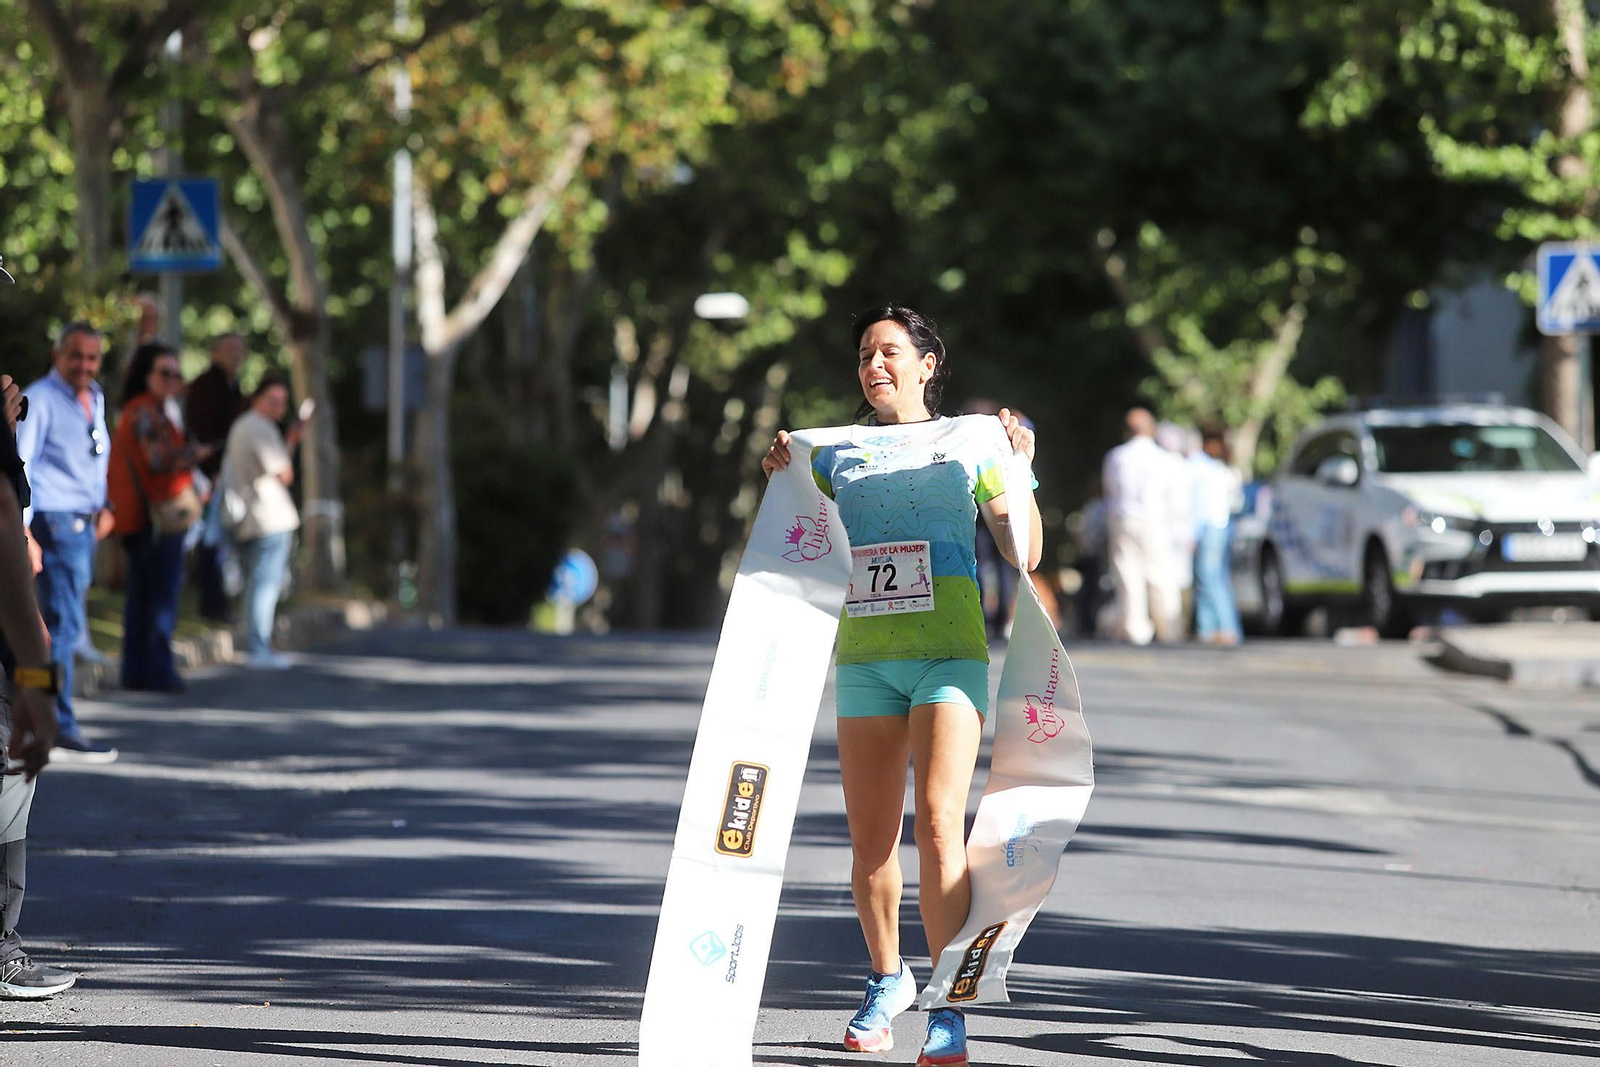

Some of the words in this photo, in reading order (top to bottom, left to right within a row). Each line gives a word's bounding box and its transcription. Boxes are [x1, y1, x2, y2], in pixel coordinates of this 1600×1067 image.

[880, 547, 888, 555] DE
[889, 546, 899, 554] LA
[900, 544, 925, 553] MUJER
[867, 563, 898, 592] 72
[722, 766, 760, 850] ekiden
[744, 832, 752, 850] Club
[748, 794, 760, 832] Deportivo
[1006, 813, 1028, 867] CORREDOR
[954, 927, 999, 995] ekiden
